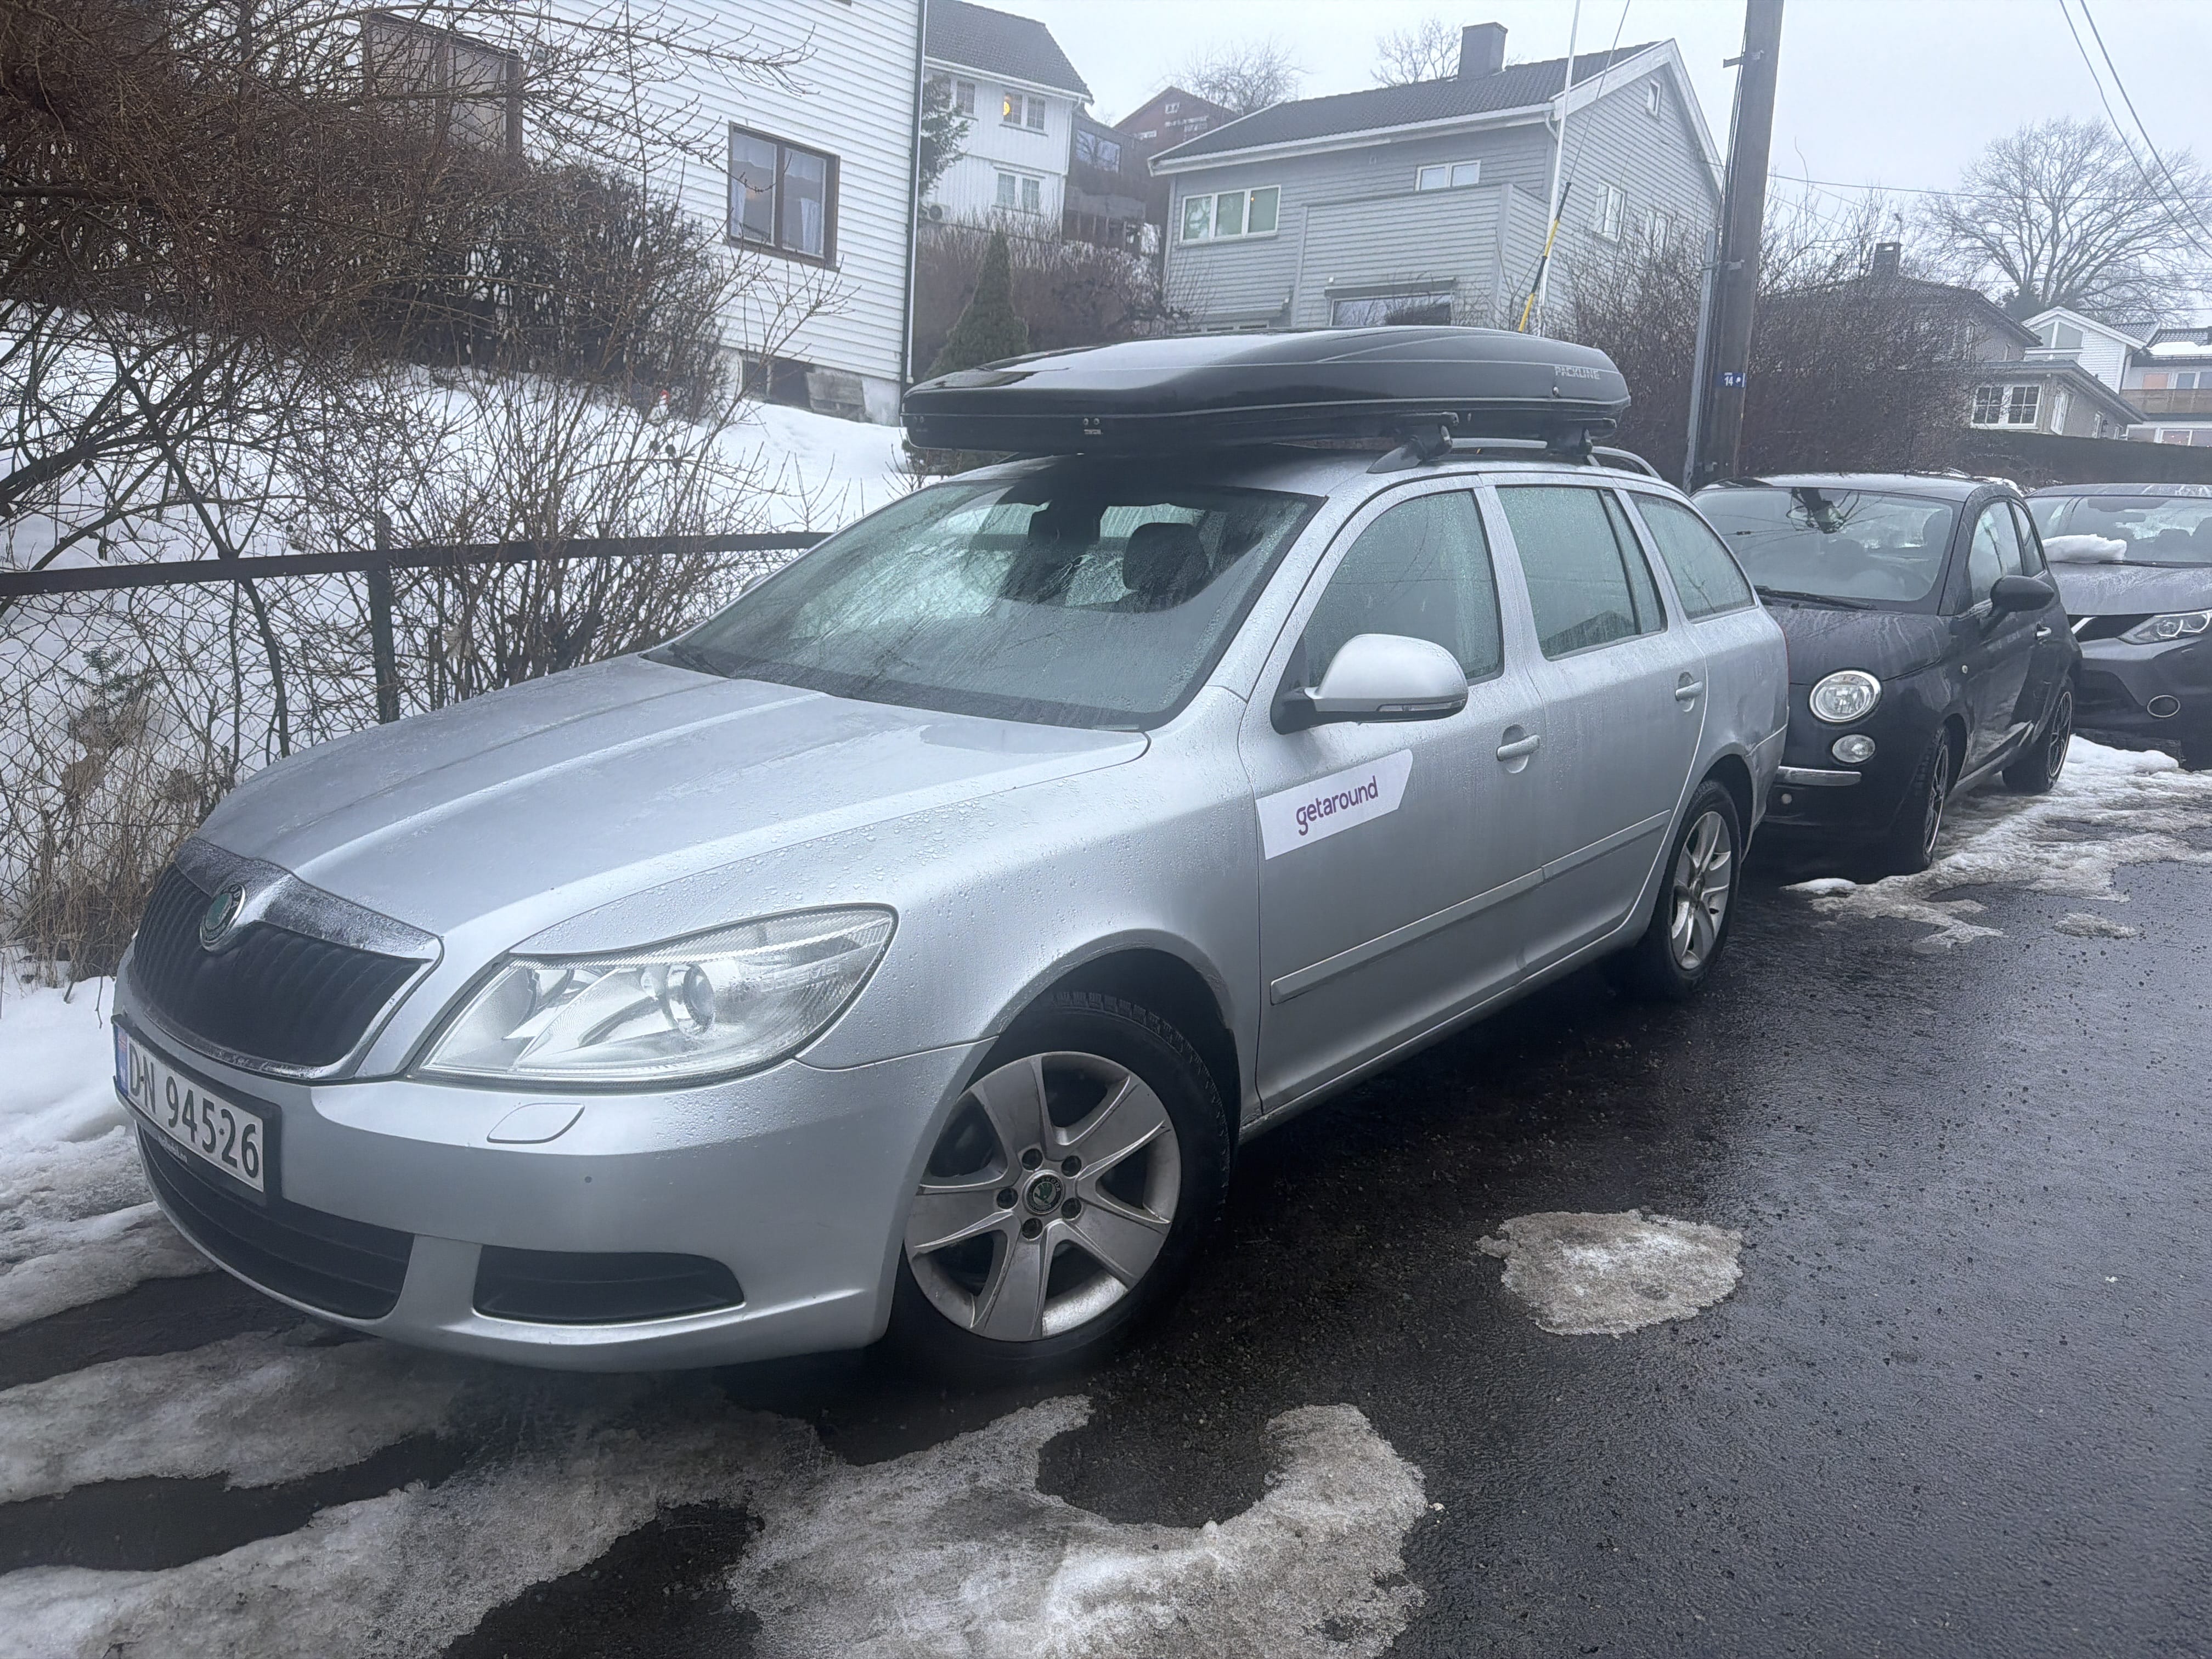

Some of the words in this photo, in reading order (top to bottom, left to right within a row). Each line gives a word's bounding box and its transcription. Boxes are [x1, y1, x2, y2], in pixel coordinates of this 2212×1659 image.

[1554, 366, 1601, 380] PACKLINE
[1724, 376, 1734, 386] 14
[1296, 775, 1379, 836] getaround
[129, 1043, 156, 1115] DN
[166, 1076, 259, 1178] 94526
